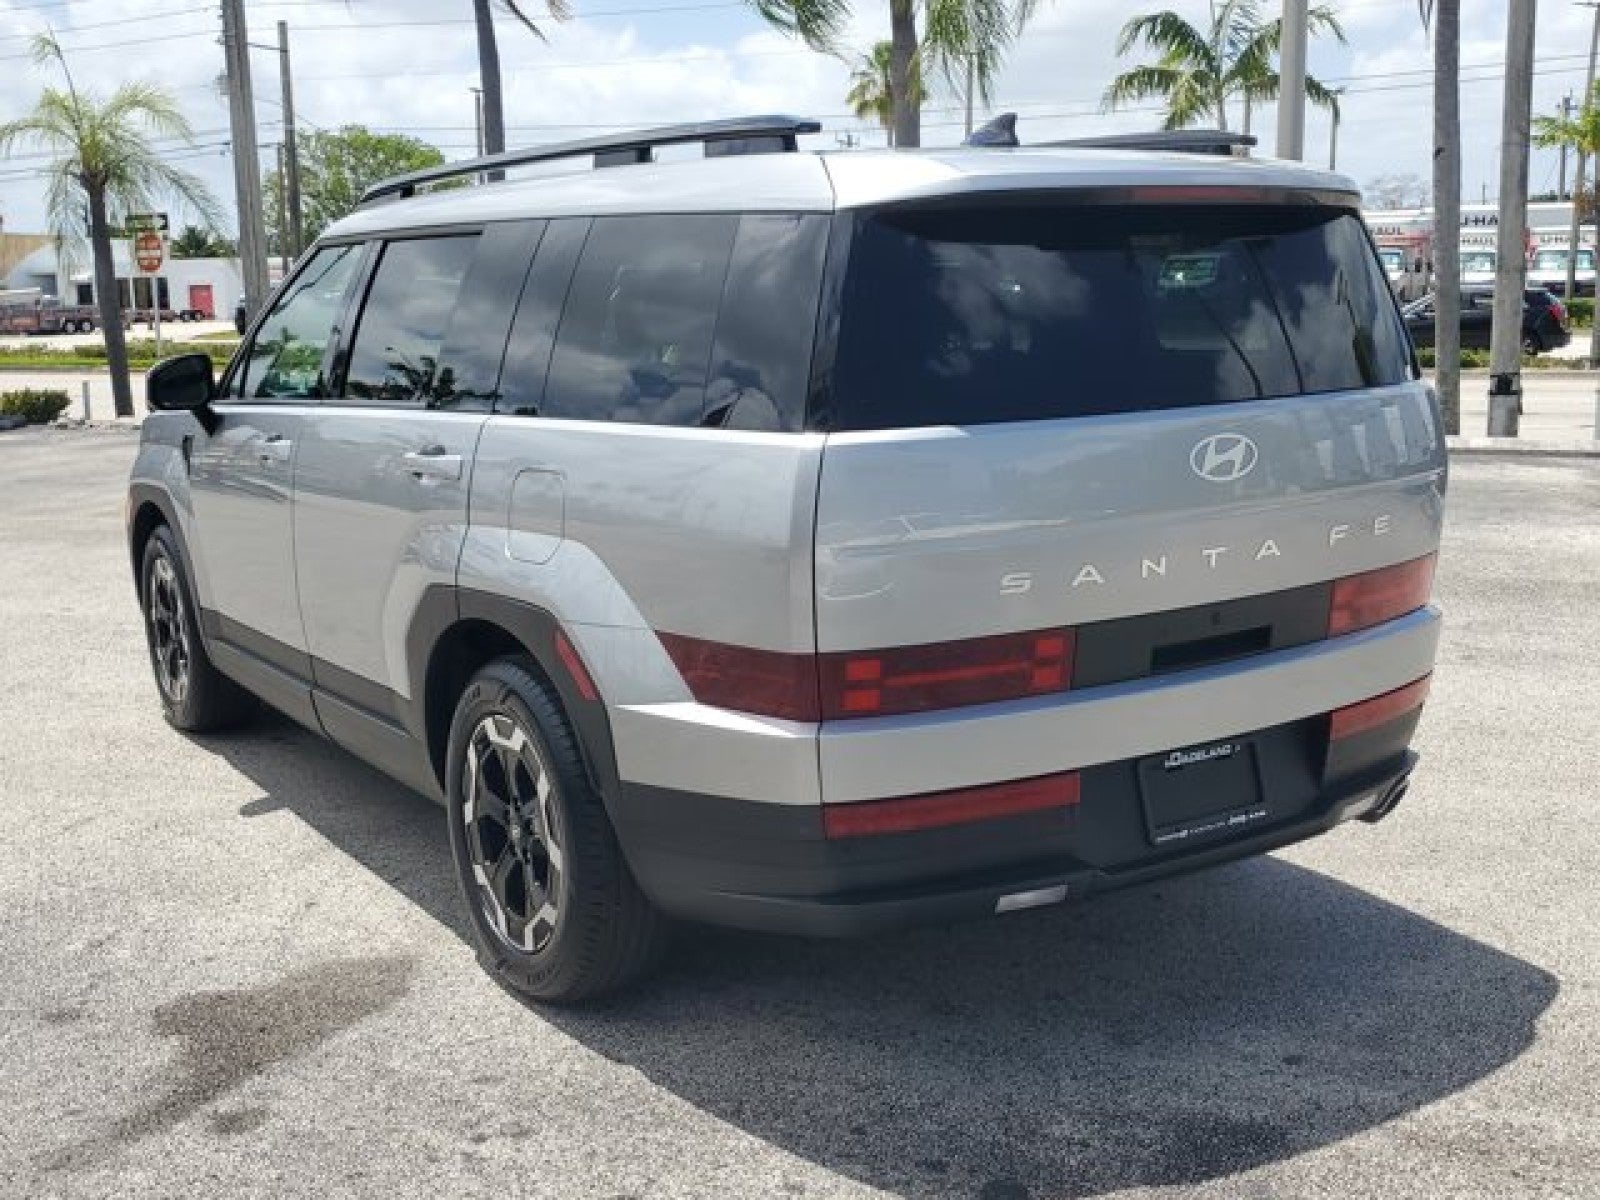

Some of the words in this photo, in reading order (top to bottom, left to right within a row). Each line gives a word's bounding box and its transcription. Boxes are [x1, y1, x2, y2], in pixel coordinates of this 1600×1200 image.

[1460, 214, 1498, 226] U-HA
[1000, 539, 1281, 594] SANTA
[1330, 514, 1391, 547] FE
